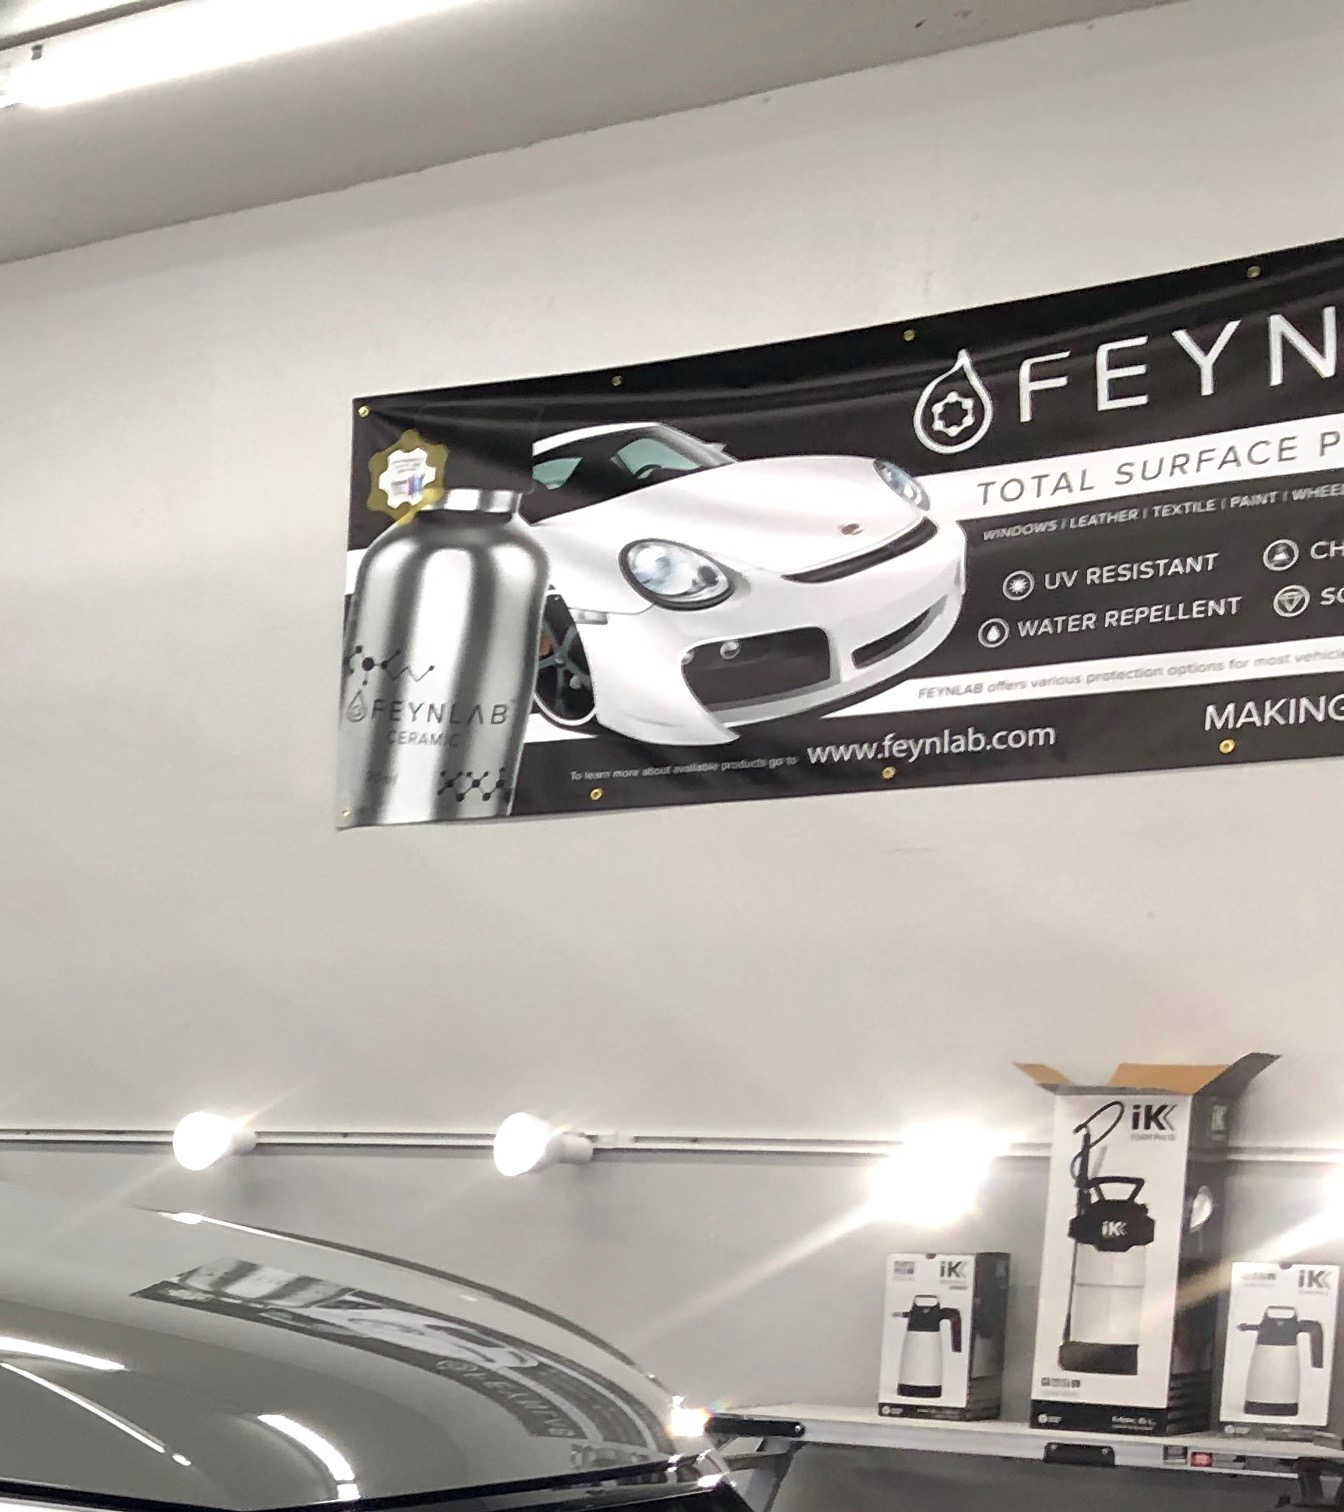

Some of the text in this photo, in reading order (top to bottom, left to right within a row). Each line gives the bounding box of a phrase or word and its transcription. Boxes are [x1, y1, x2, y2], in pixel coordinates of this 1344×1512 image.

[1018, 306, 1337, 423] FEYN
[977, 468, 1096, 505] TOTAL
[1113, 436, 1298, 486] SURFACE
[982, 519, 1058, 541] WINDOWS
[1069, 508, 1140, 529] LEATHER
[1152, 498, 1217, 518] TEXTILE
[1230, 490, 1279, 508] PAINT
[1044, 552, 1220, 590] UV RESISTANT
[1017, 596, 1243, 638] WATER REPELLENT
[918, 683, 984, 699] FEYNLAB
[987, 679, 1027, 693] offers
[1031, 674, 1081, 688] various
[1086, 667, 1164, 685] protection
[1167, 661, 1225, 677] options
[1229, 658, 1249, 669] for
[1254, 654, 1291, 667] most
[371, 699, 509, 725] FEYNLAB
[1204, 693, 1344, 731] MAKING
[389, 730, 462, 748] CERAMC
[571, 770, 582, 780] To
[584, 770, 610, 780] learn
[613, 768, 640, 778] more
[642, 766, 673, 777] about
[768, 758, 785, 769] go
[786, 756, 798, 766] to
[806, 724, 1057, 765] www.feynlab.com
